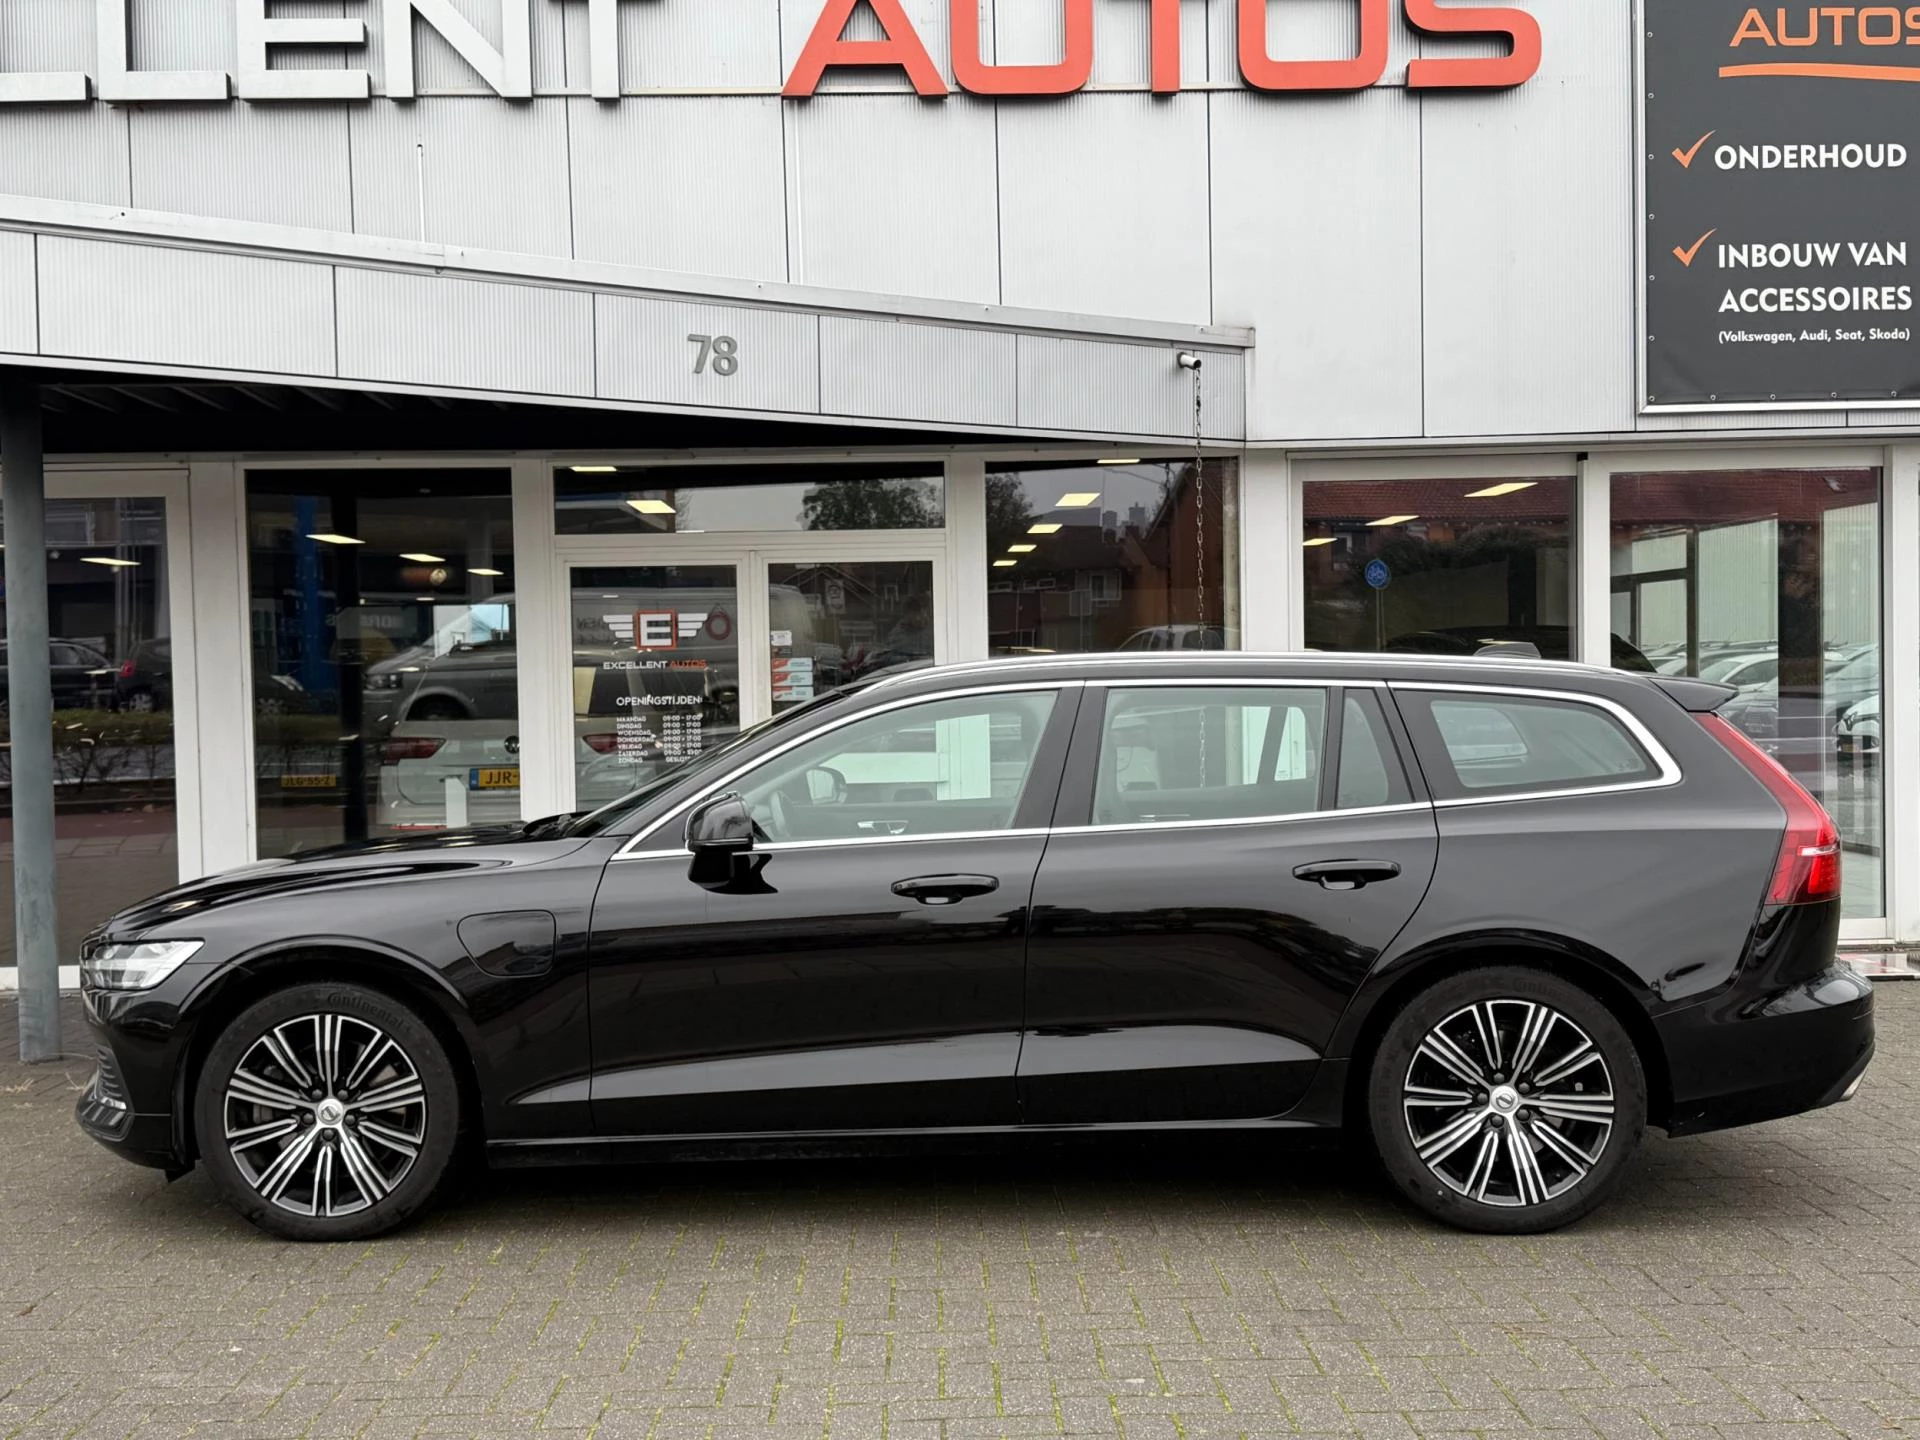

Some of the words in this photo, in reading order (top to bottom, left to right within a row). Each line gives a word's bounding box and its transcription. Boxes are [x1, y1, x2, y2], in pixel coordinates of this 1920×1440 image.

[781, 0, 1541, 97] AUTOS
[1714, 143, 1907, 170] ONDERHOUD
[1718, 242, 1841, 269] INBOUW
[1847, 241, 1907, 267] VAN
[1717, 285, 1913, 313] ACCESSOIRES
[1718, 330, 1796, 345] (Volkswagen,
[1799, 329, 1832, 343] Audi,
[1835, 328, 1866, 342] Seat,
[1869, 328, 1911, 341] Skoda)
[687, 333, 739, 376] 78
[602, 660, 668, 670] EXCELLENT
[669, 659, 708, 668] AUTOS
[327, 991, 406, 1029] Continental
